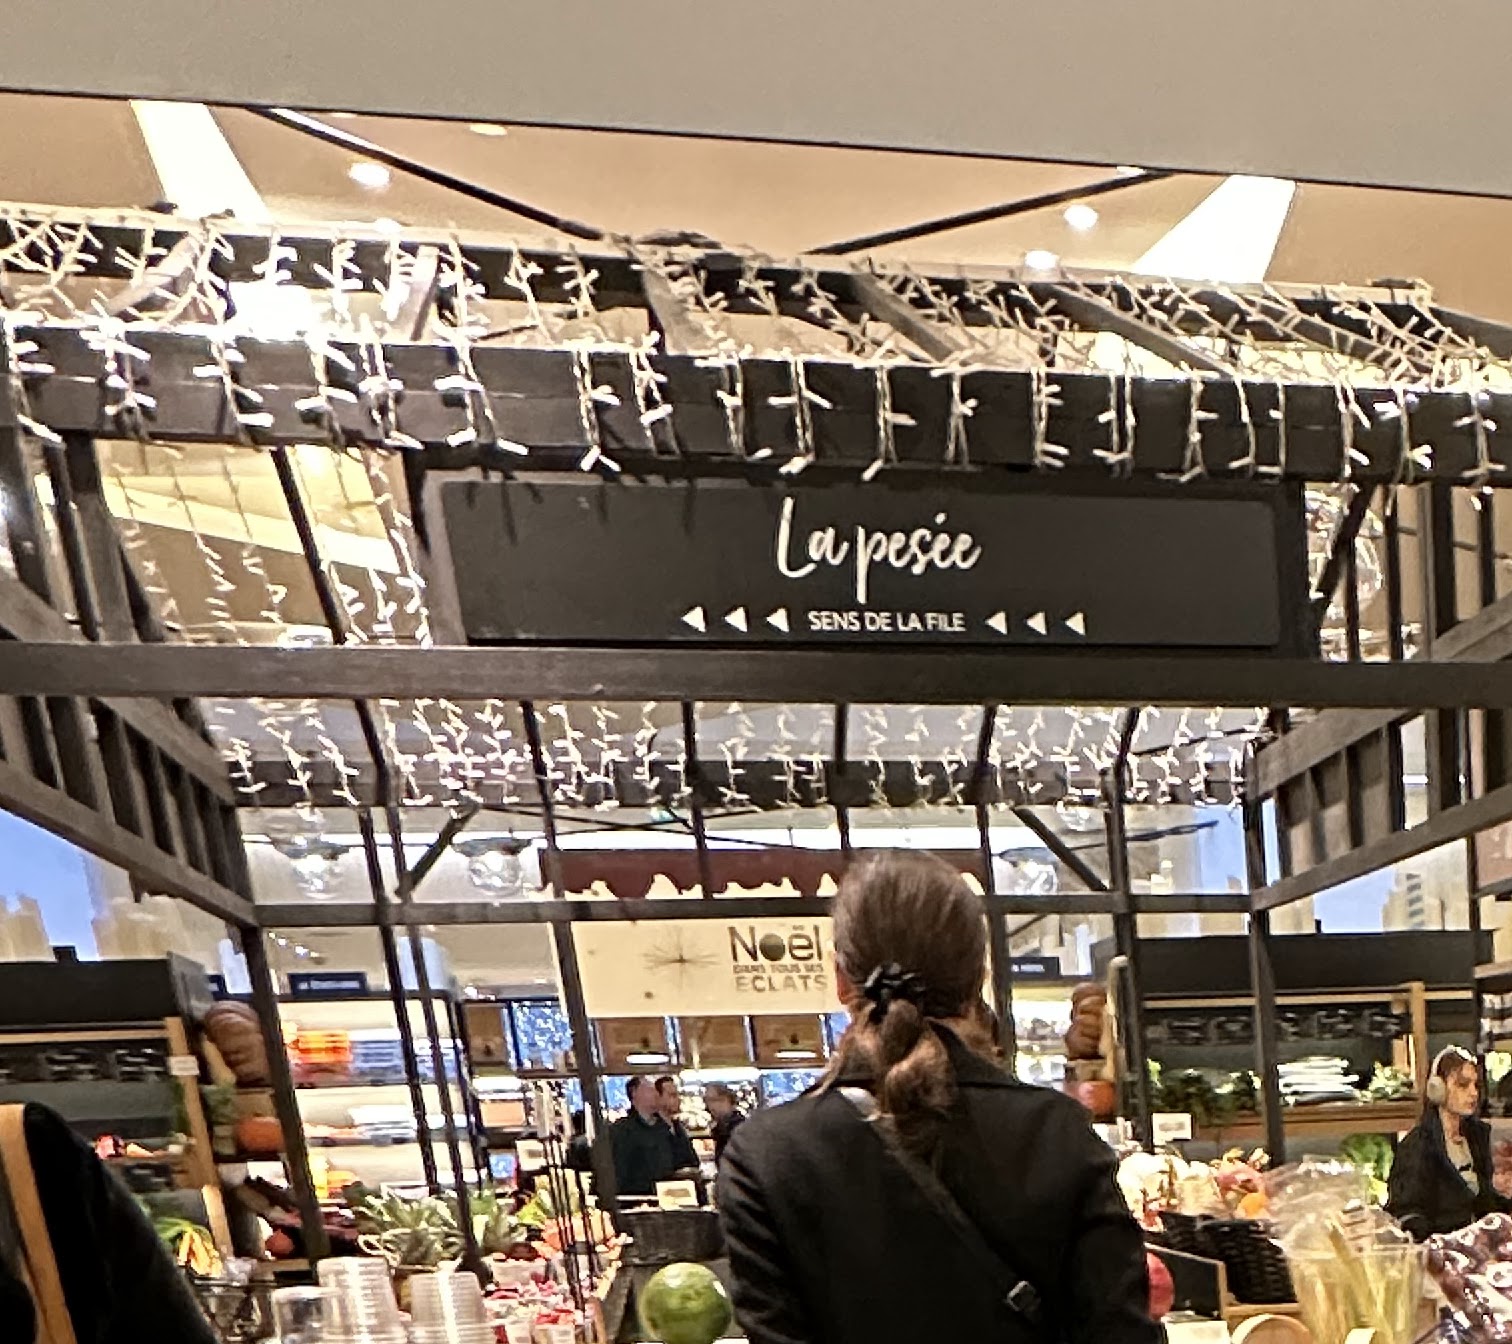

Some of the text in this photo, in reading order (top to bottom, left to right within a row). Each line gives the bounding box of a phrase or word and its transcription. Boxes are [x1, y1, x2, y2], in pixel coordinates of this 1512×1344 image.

[777, 496, 982, 605] La pesée
[807, 610, 966, 632] SENS DE LA FILE
[728, 925, 822, 961] Noël
